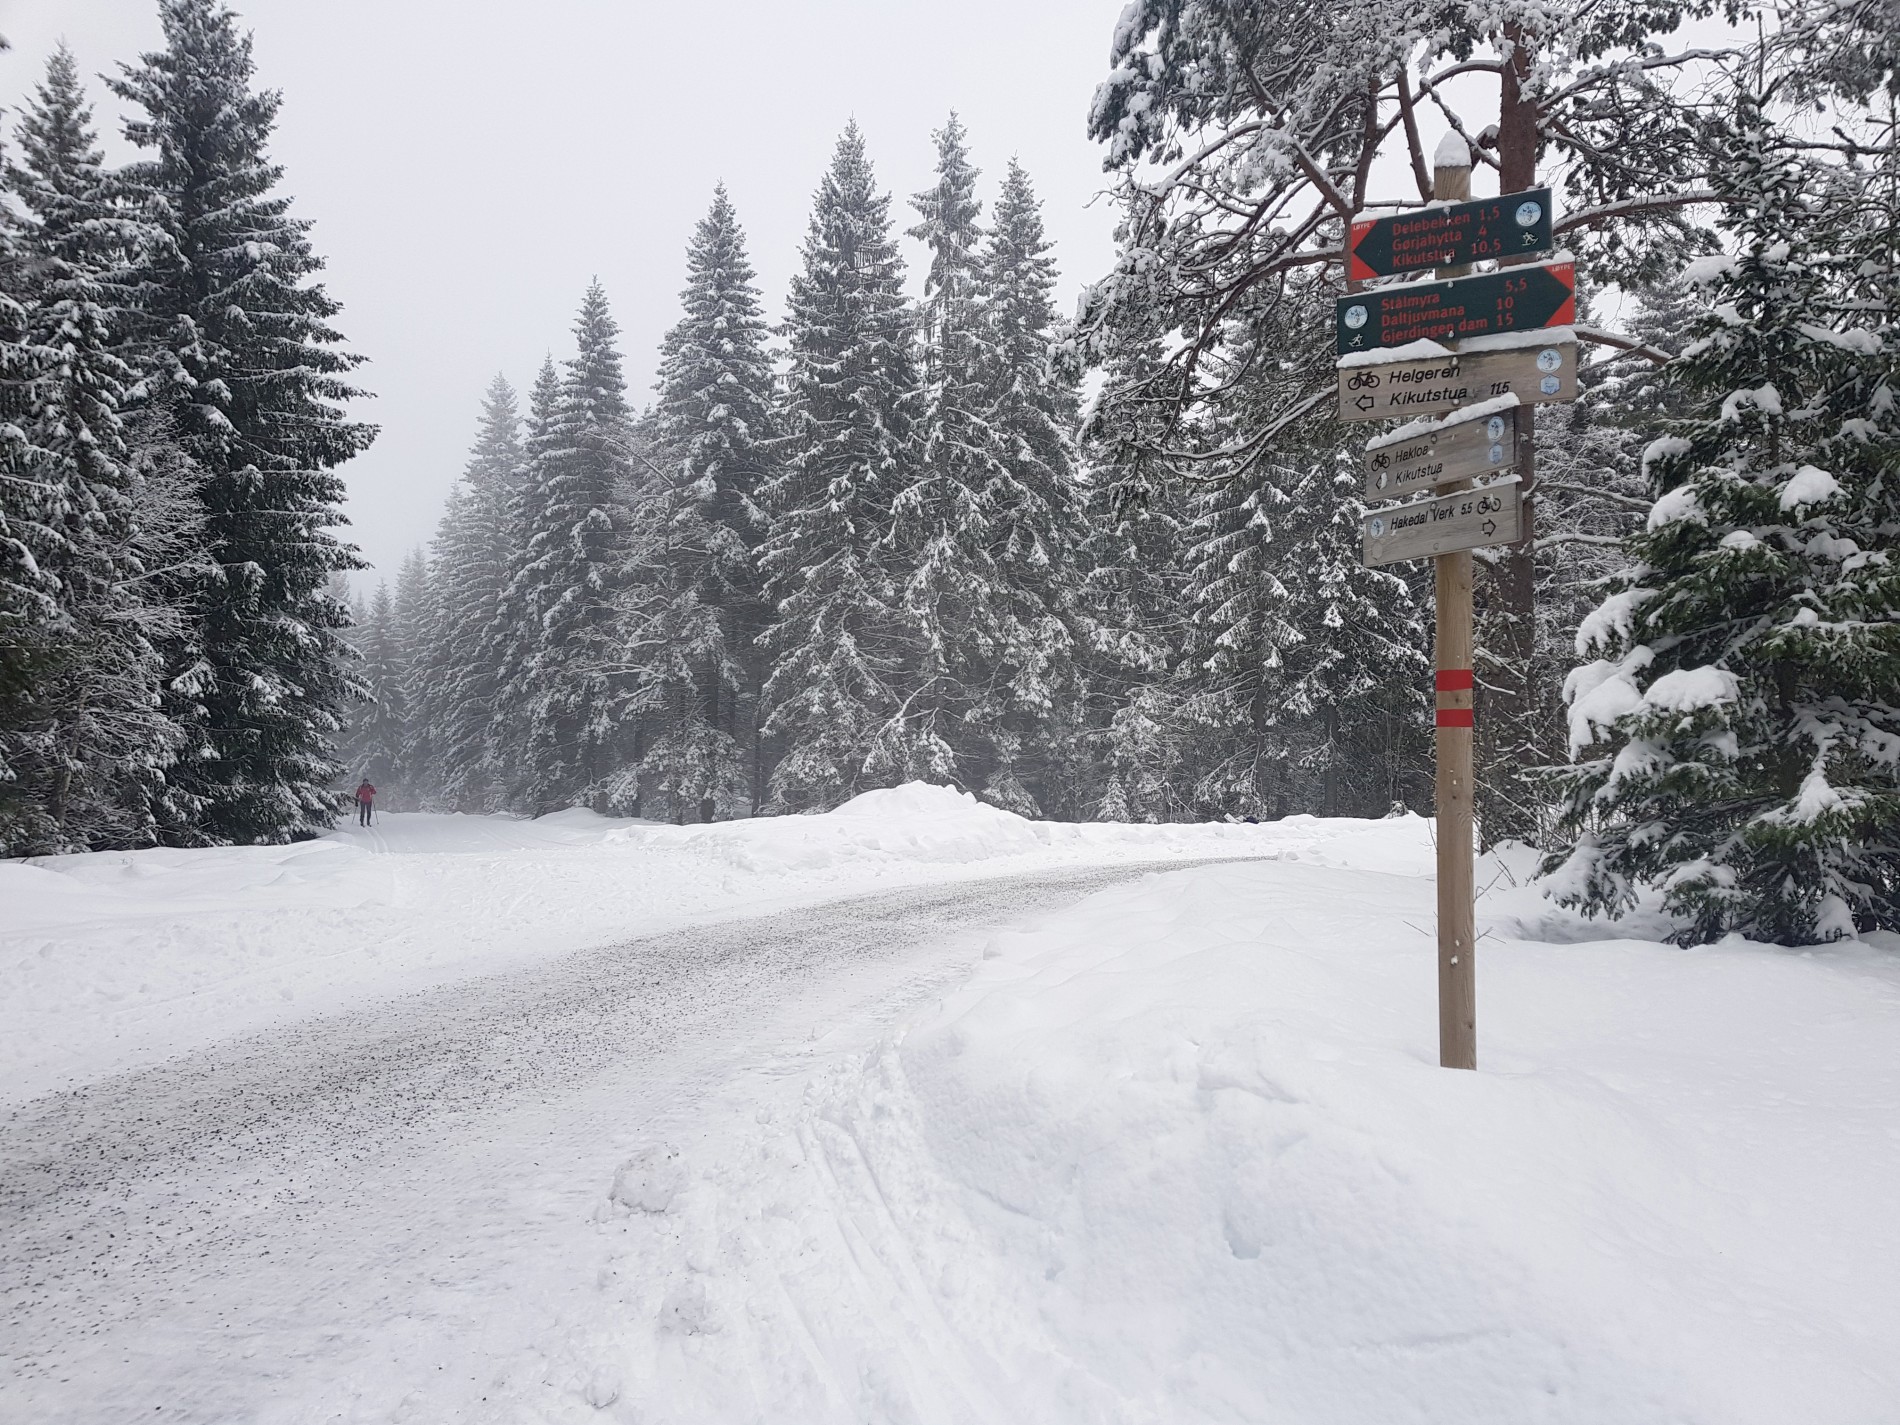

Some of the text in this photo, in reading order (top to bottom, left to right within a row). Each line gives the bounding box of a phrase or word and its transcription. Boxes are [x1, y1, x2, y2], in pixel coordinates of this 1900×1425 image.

[1479, 206, 1501, 222] 1.5
[1392, 224, 1487, 252] Gørjahytta 4
[1392, 239, 1502, 267] Kikutstua 10.5
[1381, 278, 1527, 311] Stålmyra 5.5
[1381, 297, 1514, 328] Daltjuvmana 10
[1381, 313, 1514, 345] Gjerdingen dam 15
[1389, 366, 1460, 387] Helgeren
[1389, 386, 1467, 406] Kikutstua
[1395, 444, 1428, 464] Hakloa
[1395, 461, 1443, 484] Kikutstua
[1390, 502, 1473, 530] Hakedal Verk 5.5
